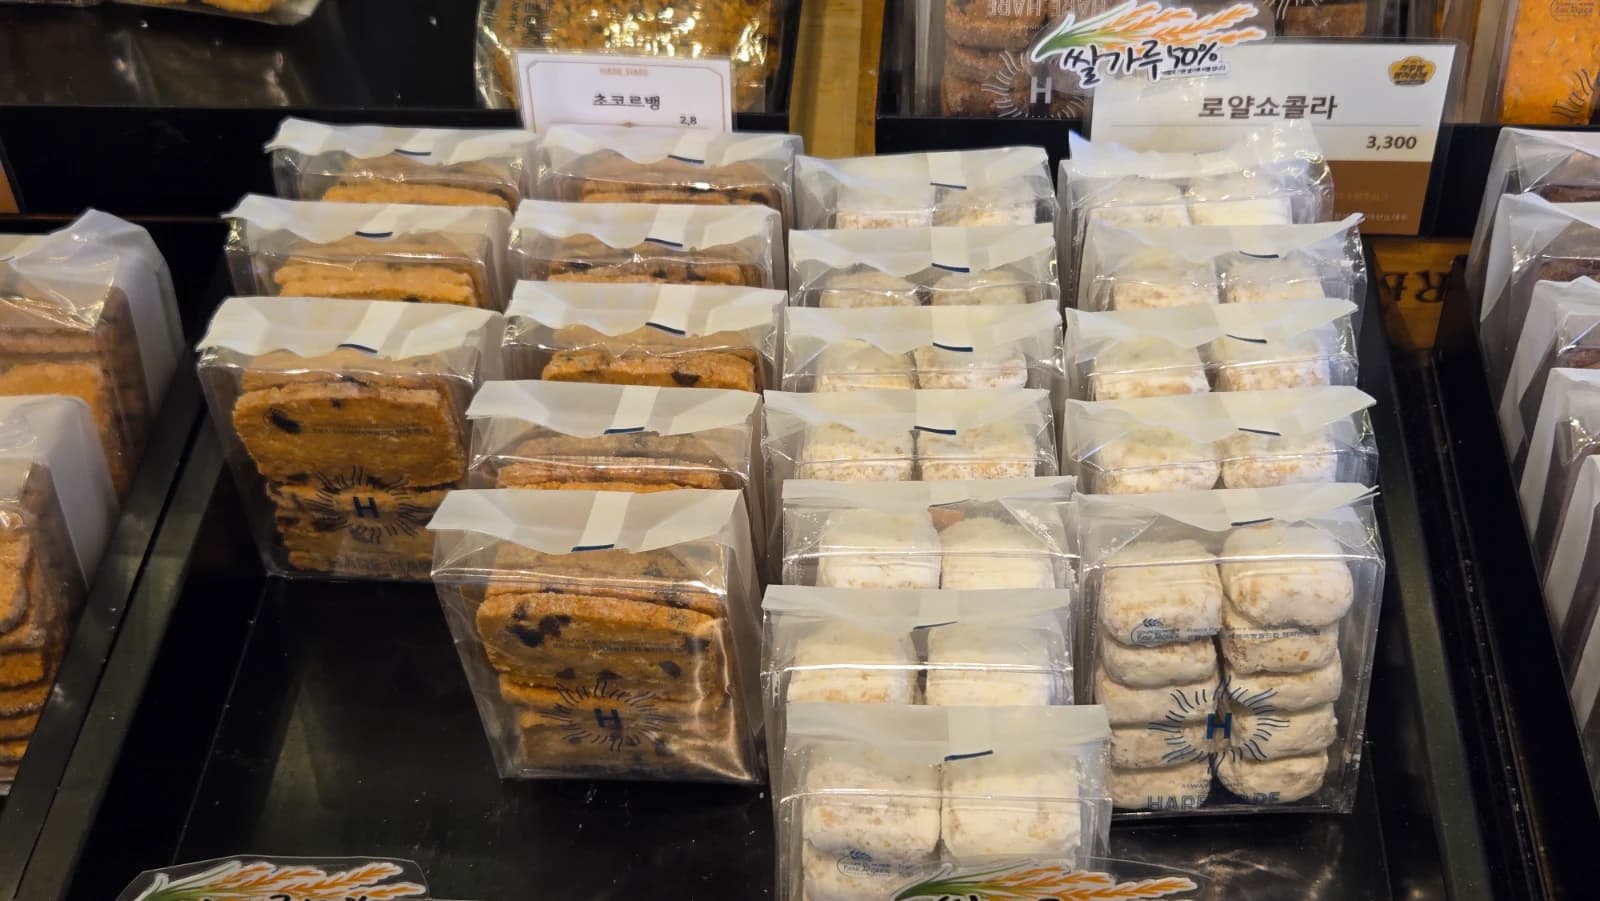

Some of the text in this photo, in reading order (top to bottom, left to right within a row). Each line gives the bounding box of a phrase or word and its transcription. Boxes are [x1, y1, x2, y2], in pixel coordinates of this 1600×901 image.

[1063, 39, 1218, 86] 쌀가루 50%
[592, 93, 661, 111] 초코르뱅
[1198, 94, 1338, 120] 로얄쇼콜라
[1366, 135, 1418, 151] 3,300
[353, 496, 379, 518] H
[594, 708, 623, 730] H
[1206, 712, 1232, 739] H
